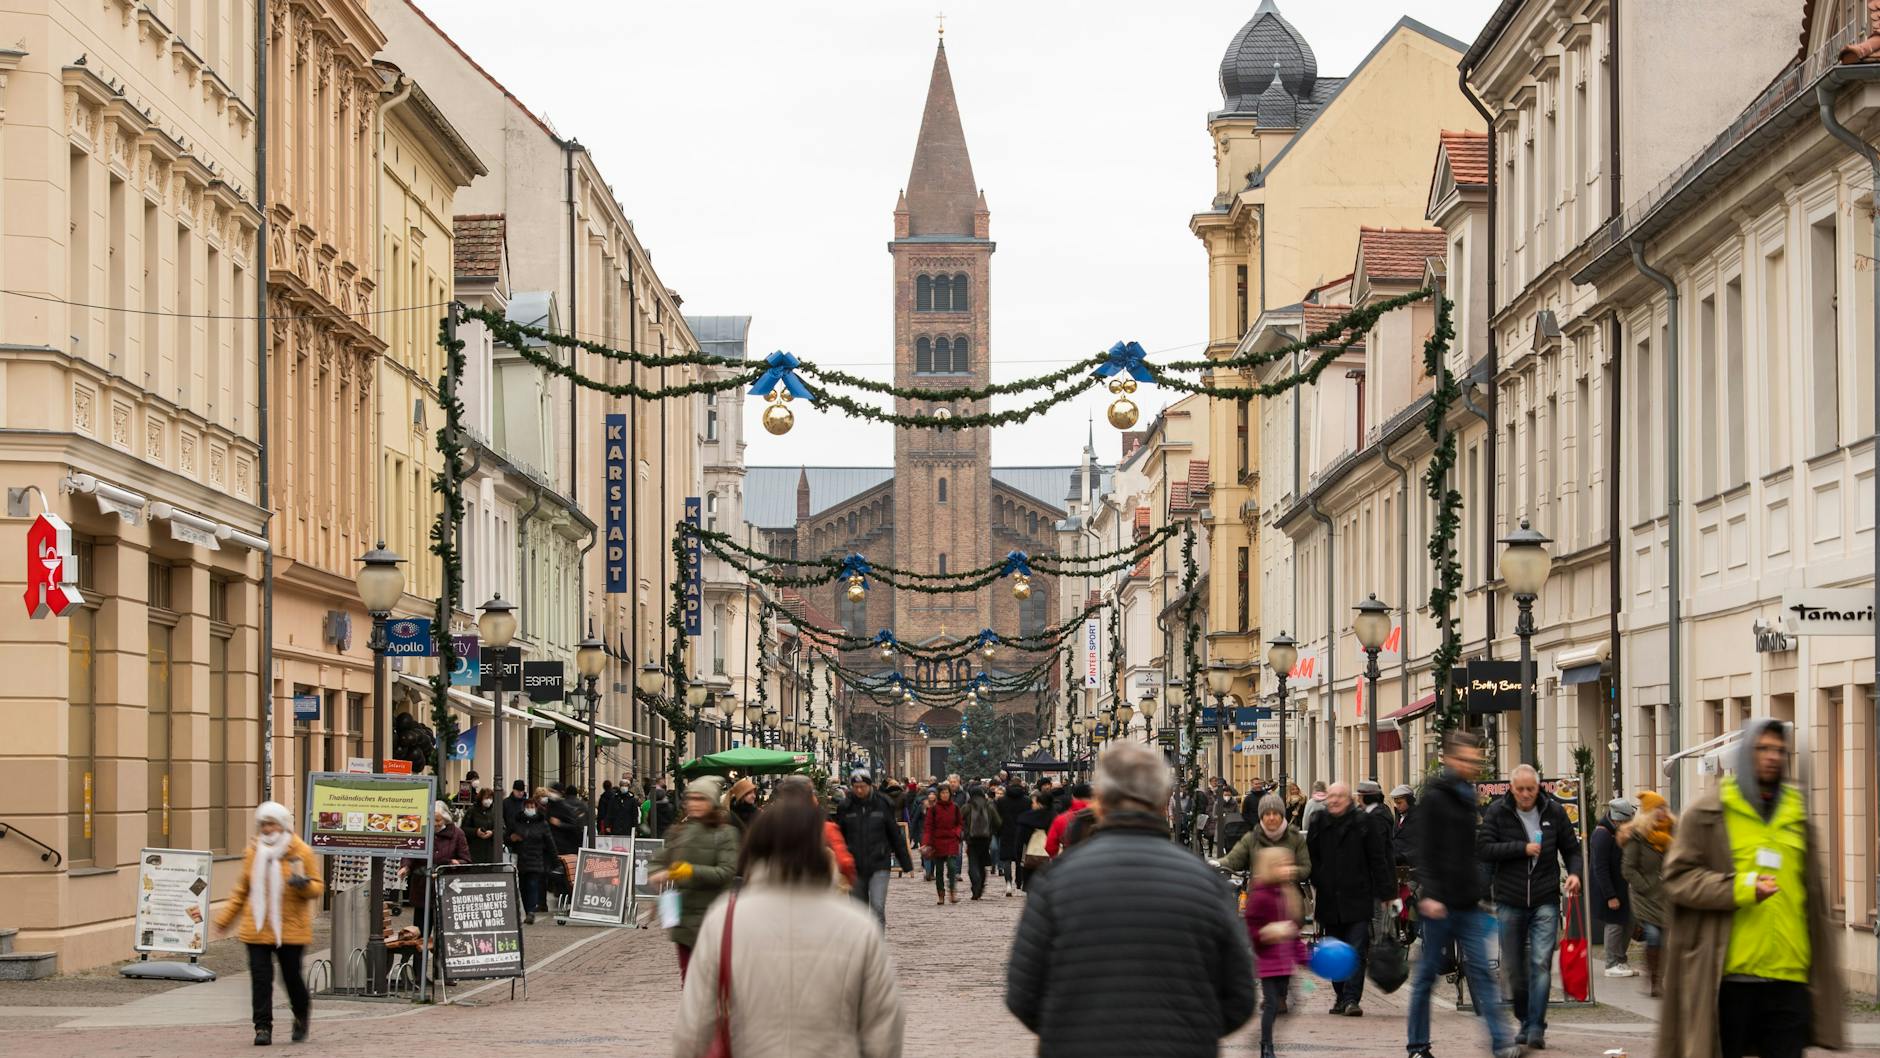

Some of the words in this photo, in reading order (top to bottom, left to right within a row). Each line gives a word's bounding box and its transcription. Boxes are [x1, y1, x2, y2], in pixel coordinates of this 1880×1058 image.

[607, 425, 625, 582] KARSTADT
[1789, 603, 1876, 621] Tamari
[387, 641, 424, 654] Apollo
[480, 663, 519, 675] ESRIT
[525, 675, 562, 687] ESPRIT
[452, 894, 484, 904] SMOKING
[583, 894, 612, 908] 50%
[452, 900, 508, 913] REFRESHMENTS
[453, 911, 480, 921] COFFEE
[481, 910, 491, 919] TO
[492, 909, 503, 918] GO
[454, 921, 461, 930] &
[462, 919, 483, 929] MANY
[485, 917, 505, 927] MORE
